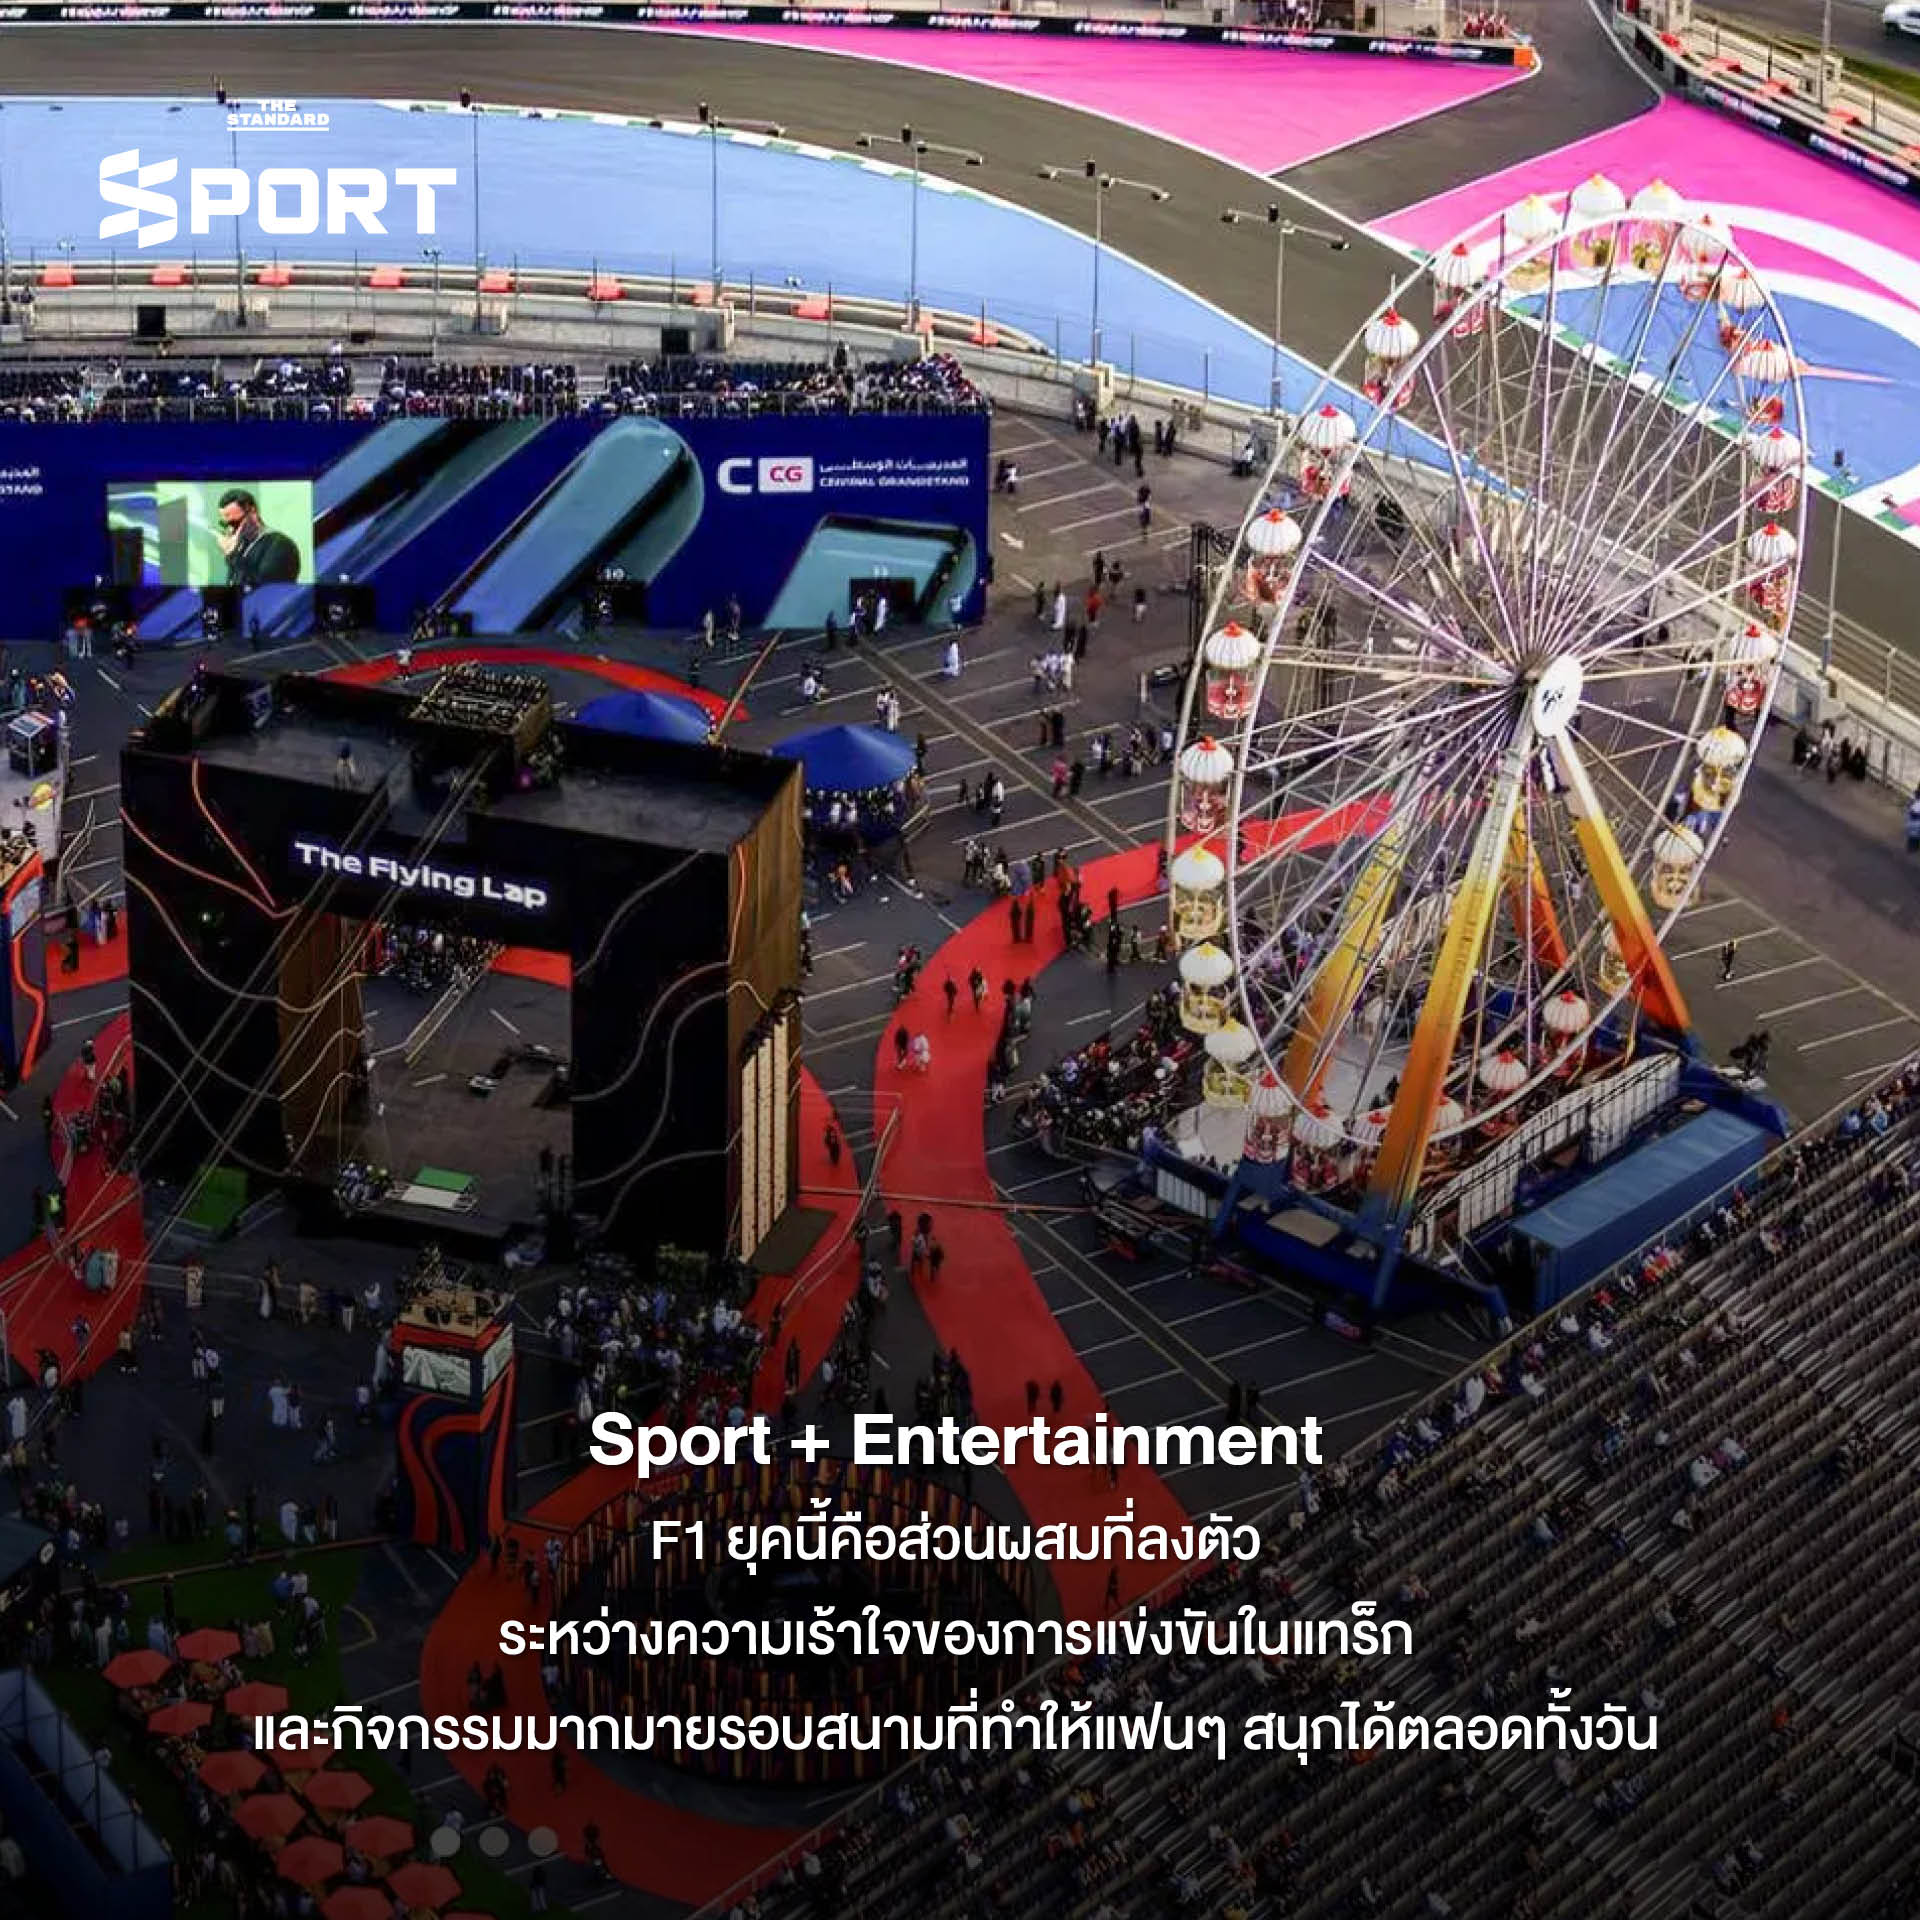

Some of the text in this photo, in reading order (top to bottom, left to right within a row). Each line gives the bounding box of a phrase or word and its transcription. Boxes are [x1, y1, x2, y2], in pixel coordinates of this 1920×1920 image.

[769, 465, 804, 483] CG
[295, 841, 548, 909] The Flying Lap
